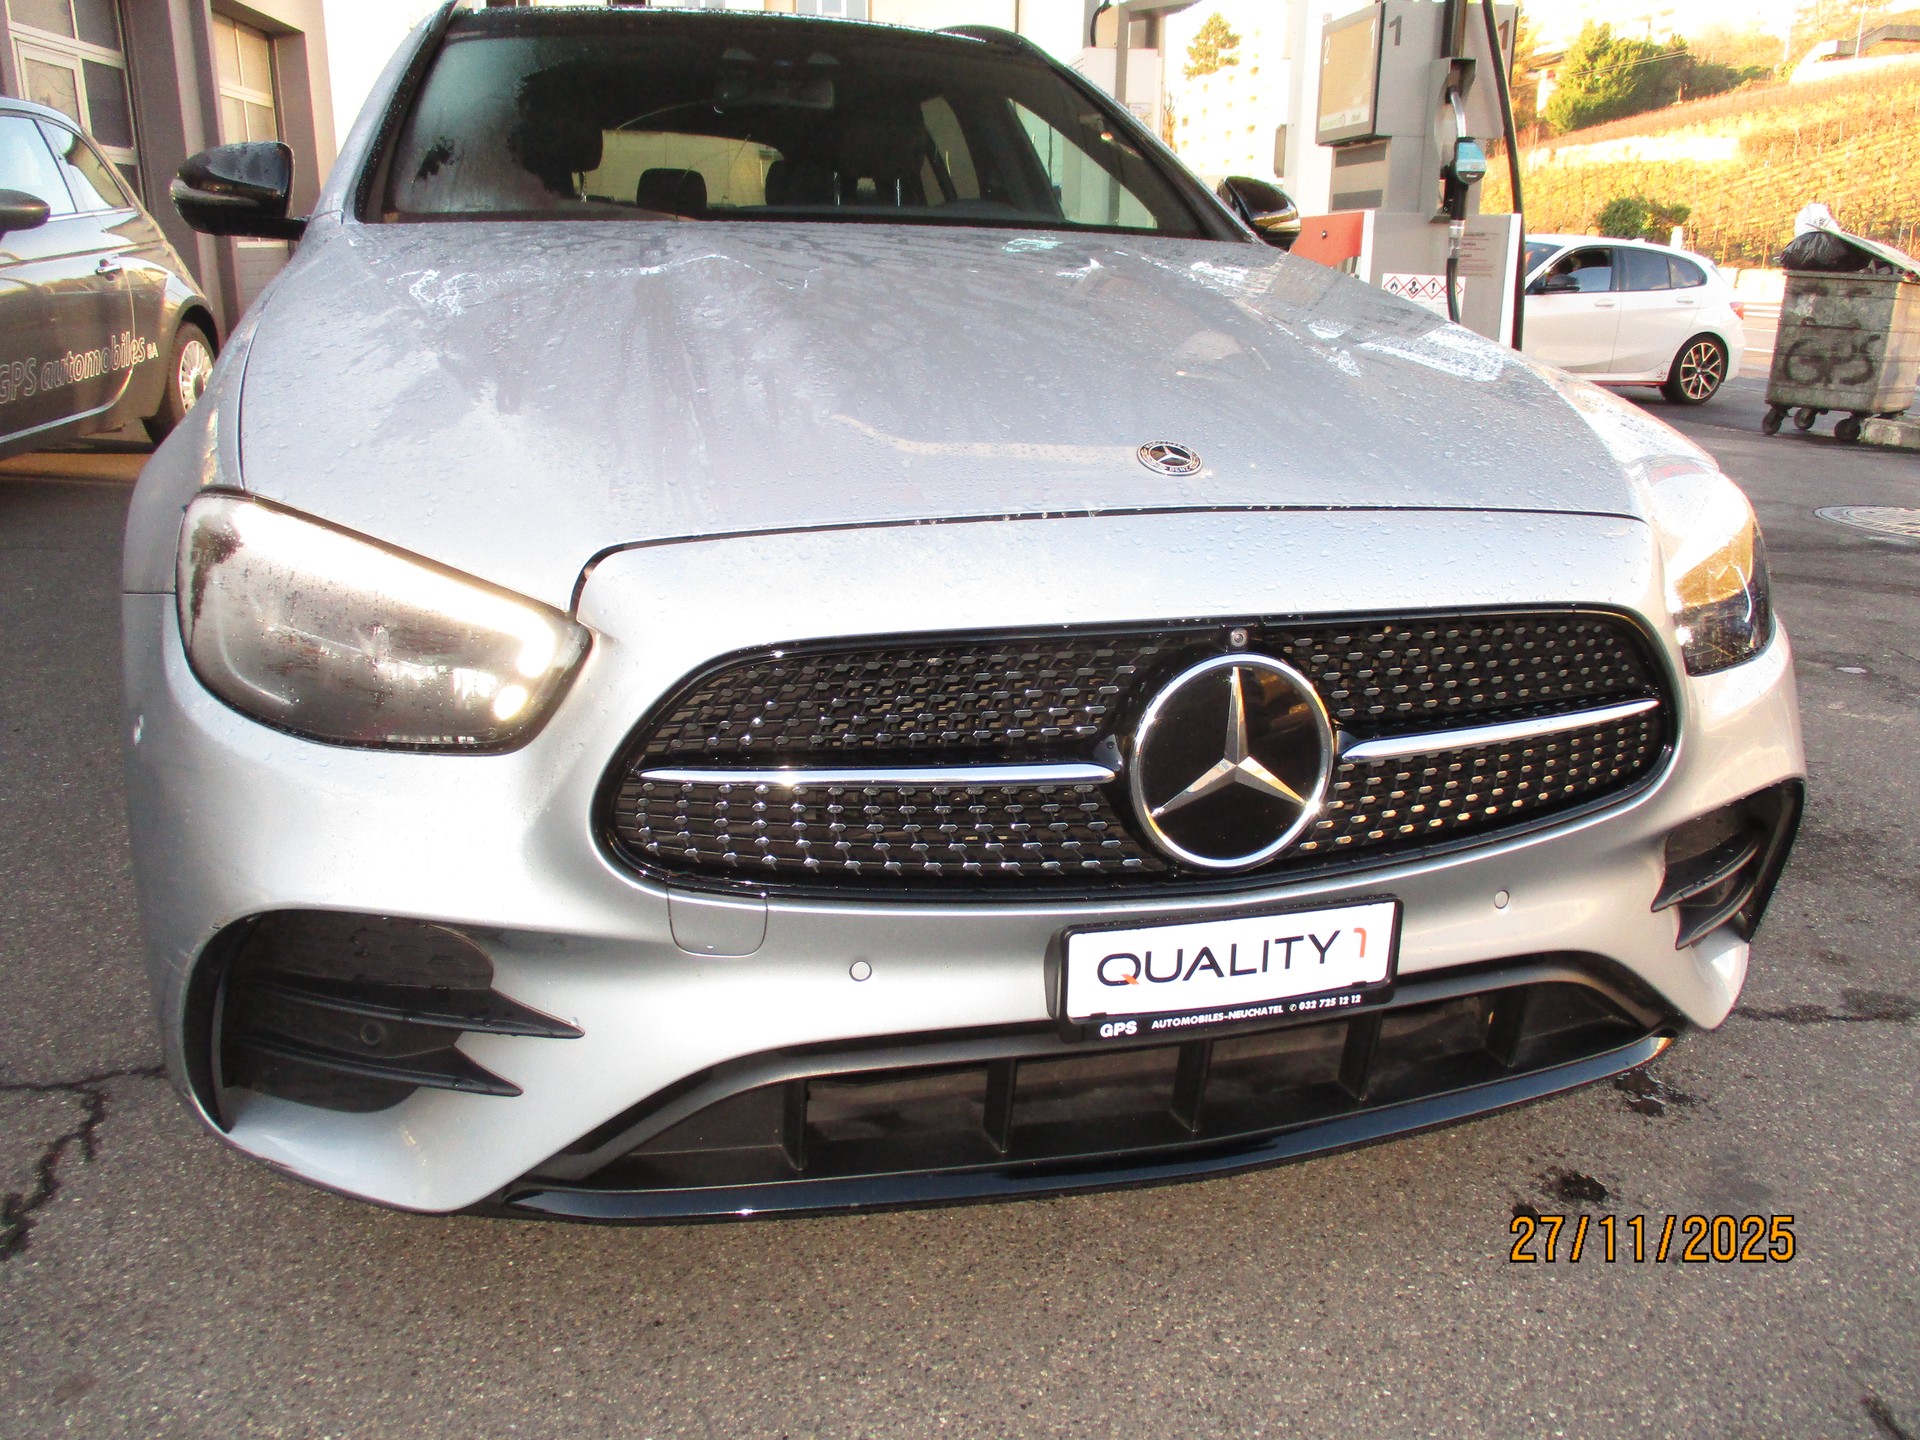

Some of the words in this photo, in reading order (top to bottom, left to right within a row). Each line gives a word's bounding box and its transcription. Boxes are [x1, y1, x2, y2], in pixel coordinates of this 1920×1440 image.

[1389, 15, 1402, 46] 1
[0, 357, 37, 404] GPS
[40, 331, 147, 391] automobiles
[147, 342, 159, 360] SA
[1097, 930, 1341, 987] QUALITY
[1353, 927, 1367, 959] 1
[1100, 1020, 1137, 1038] GPS
[1151, 1004, 1284, 1030] AUTOMOBILES-NEUCHATEL
[1298, 998, 1317, 1011] 032
[1318, 996, 1337, 1009] 725
[1338, 995, 1349, 1006] 12
[1350, 994, 1362, 1005] 12
